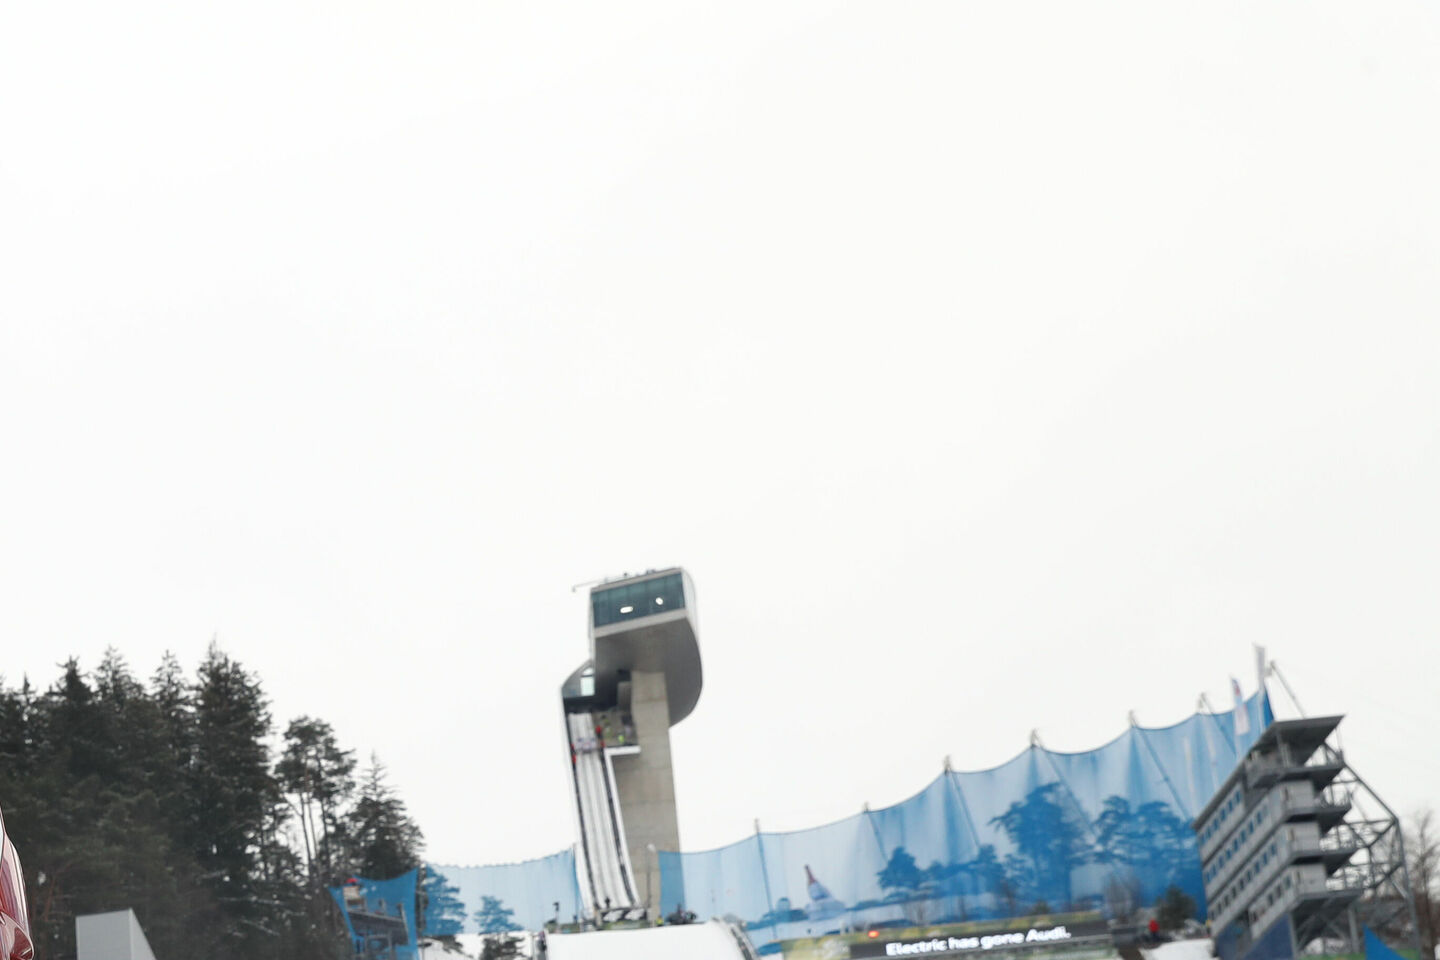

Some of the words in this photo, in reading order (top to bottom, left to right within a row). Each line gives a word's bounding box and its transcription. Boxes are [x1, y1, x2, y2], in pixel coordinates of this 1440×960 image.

[886, 939, 947, 956] Electric
[948, 936, 980, 950] has
[980, 932, 1025, 950] gone
[1026, 926, 1072, 943] Audi.
